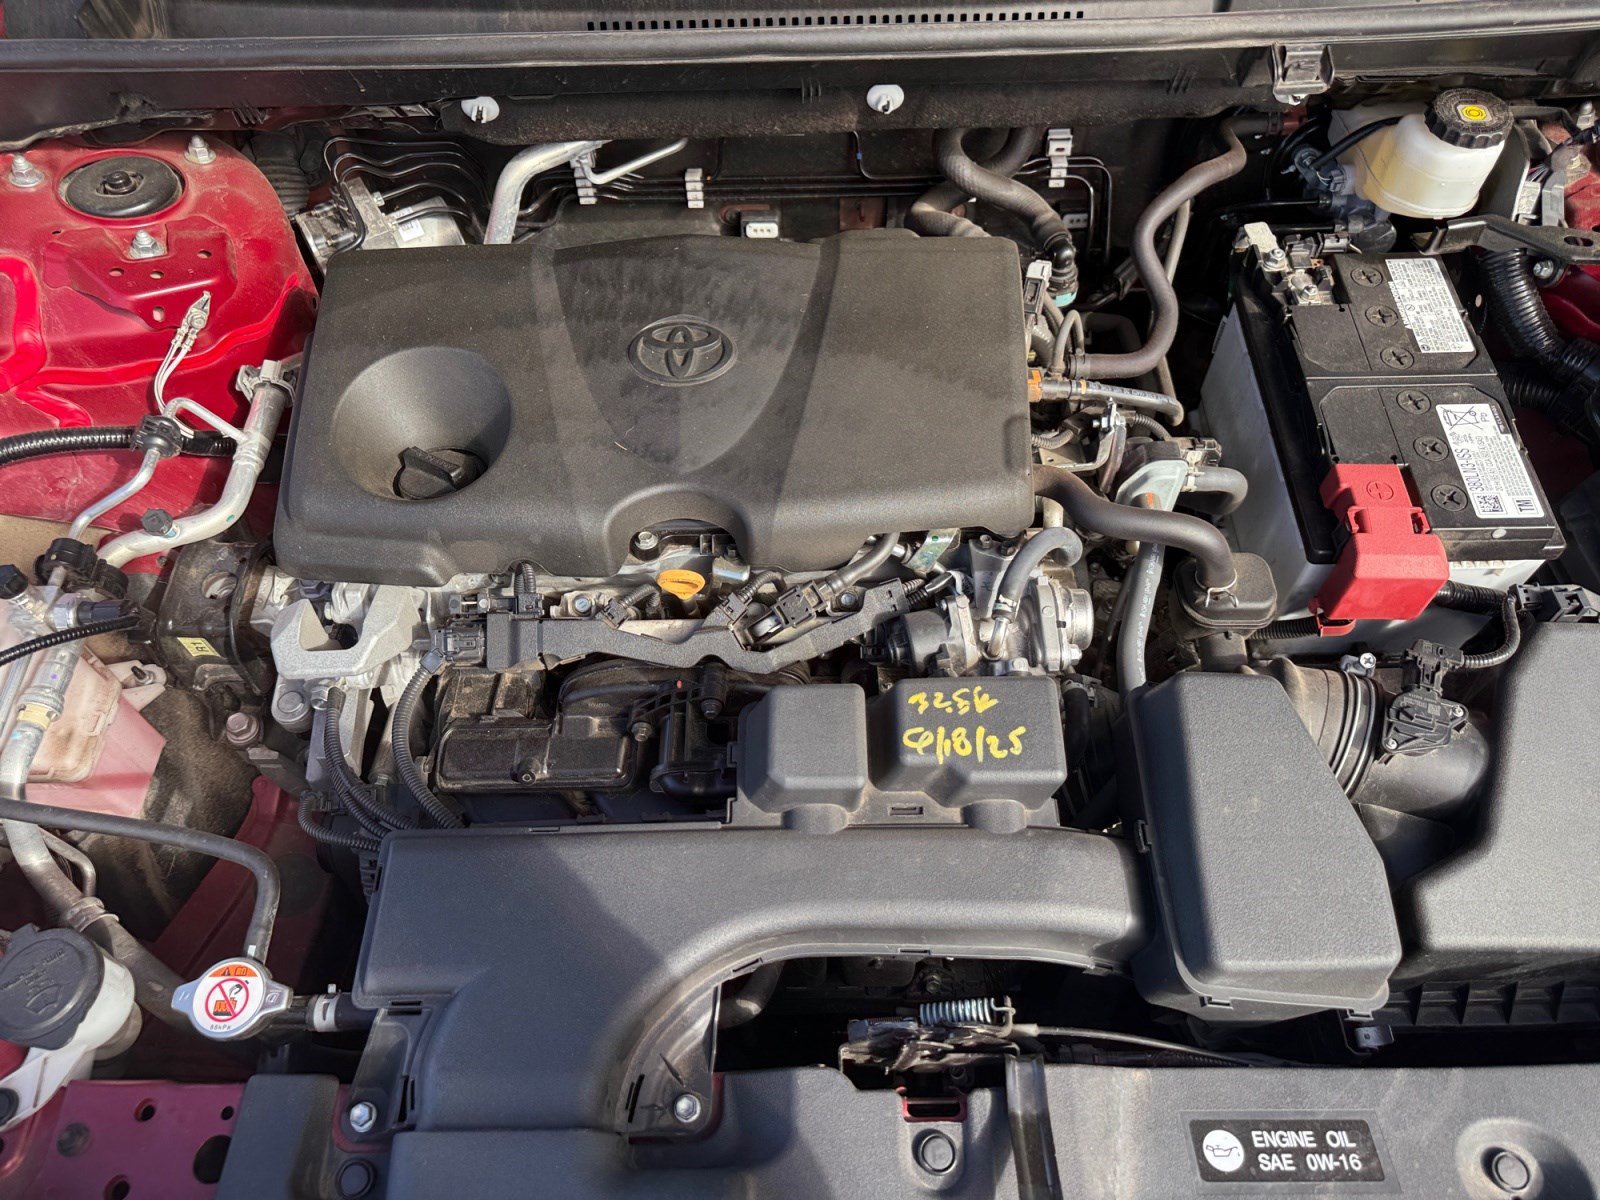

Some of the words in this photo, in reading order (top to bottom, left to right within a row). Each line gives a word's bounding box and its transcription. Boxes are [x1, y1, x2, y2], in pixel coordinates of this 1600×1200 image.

[1515, 500, 1535, 512] TM
[903, 726, 1026, 764] 9/18/25
[1251, 1130, 1317, 1148] ENGINE
[1326, 1130, 1356, 1148] OIL
[1257, 1153, 1296, 1171] SAE
[1306, 1153, 1362, 1171] 0W-16
